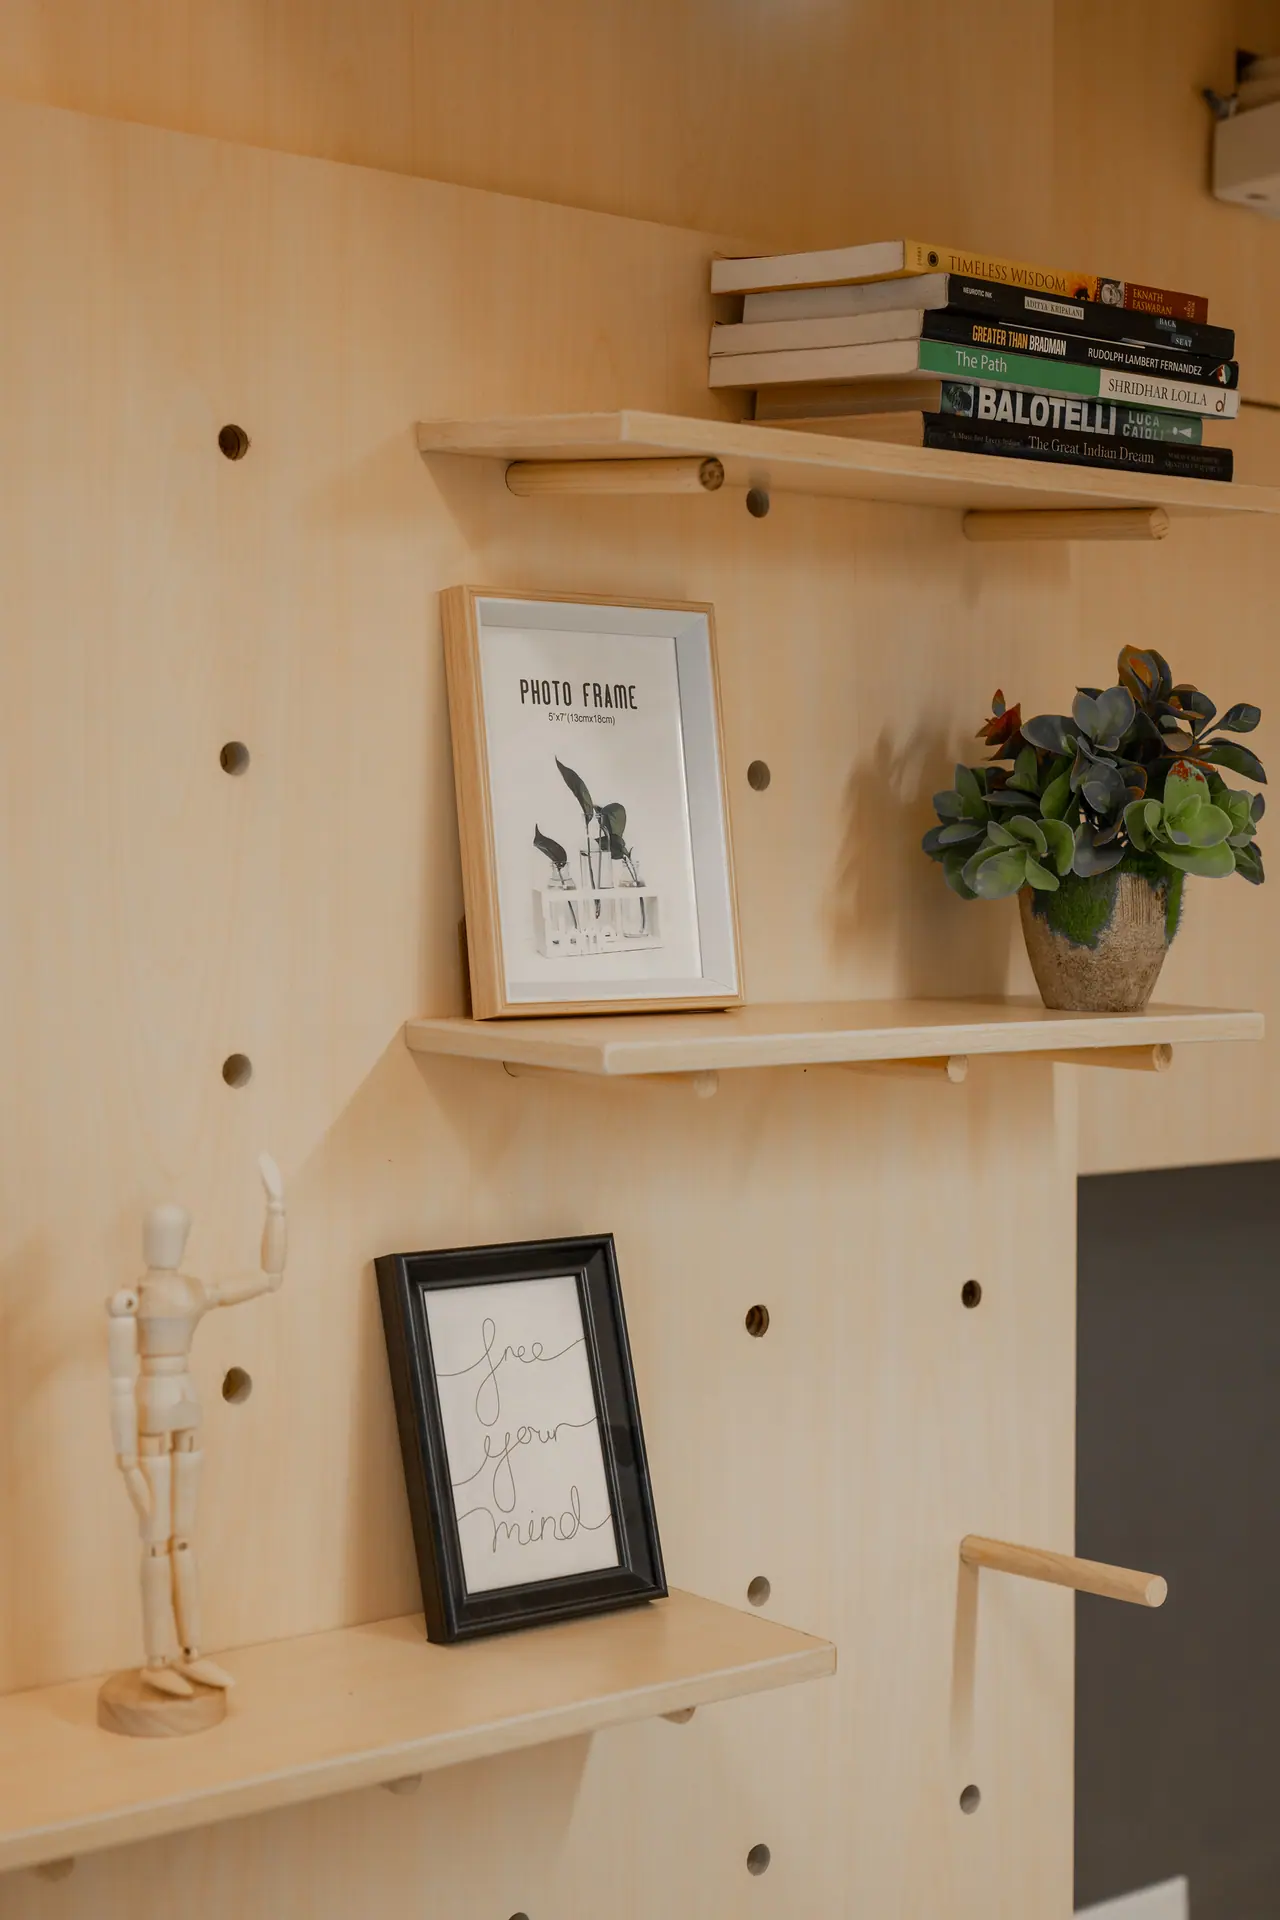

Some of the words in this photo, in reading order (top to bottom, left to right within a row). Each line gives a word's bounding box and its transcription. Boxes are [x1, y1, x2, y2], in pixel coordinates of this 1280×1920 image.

[948, 256, 1007, 281] TIMELESS
[1010, 267, 1066, 292] WISDOM
[1026, 299, 1048, 311] ADITYA
[1132, 300, 1172, 316] EASWARAN
[1133, 289, 1163, 303] EKNATH
[1159, 318, 1177, 328] BACK
[972, 325, 1006, 346] GREATER
[1008, 331, 1028, 350] THAN
[1029, 334, 1067, 356] BRADMAN
[1175, 337, 1193, 348] SEAT
[956, 350, 978, 369] The
[981, 354, 1007, 373] Path
[1088, 347, 1124, 364] RUDOLPH
[1125, 352, 1159, 369] LAMBERT
[1160, 359, 1202, 376] FERNANDEZ
[1108, 378, 1168, 400] SHRIDHAR
[1171, 388, 1207, 406] LOLLA
[977, 387, 1116, 436] BALOTELLI
[1128, 410, 1160, 427] LUCA
[1122, 424, 1164, 441] CAIOLI
[1028, 435, 1049, 451] The
[1051, 439, 1080, 455] Great
[1083, 442, 1117, 460] Indian
[1119, 446, 1154, 464] Dream
[519, 679, 572, 706] PHOTO
[582, 682, 638, 709] FRAME
[457, 1485, 613, 1553] mind
